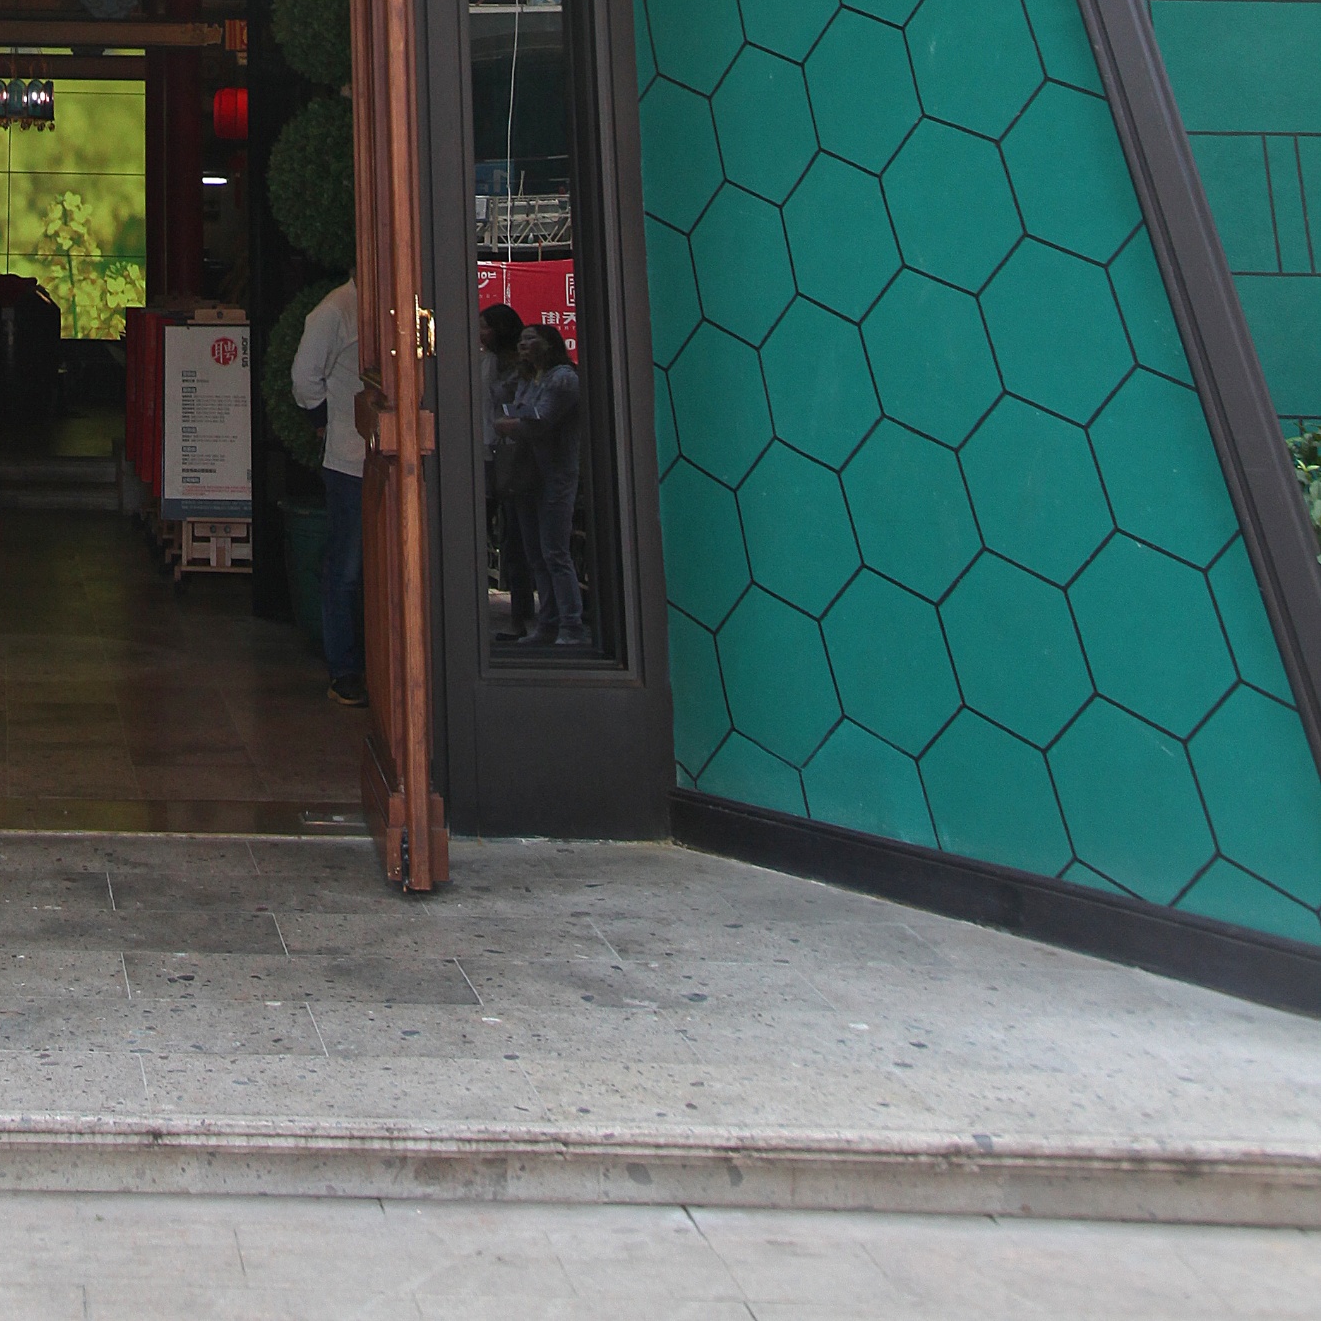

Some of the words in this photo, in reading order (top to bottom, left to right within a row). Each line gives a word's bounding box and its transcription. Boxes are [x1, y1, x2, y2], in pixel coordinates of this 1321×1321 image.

[212, 339, 236, 365] 聘
[241, 336, 249, 355] JOIN
[241, 356, 249, 368] US
